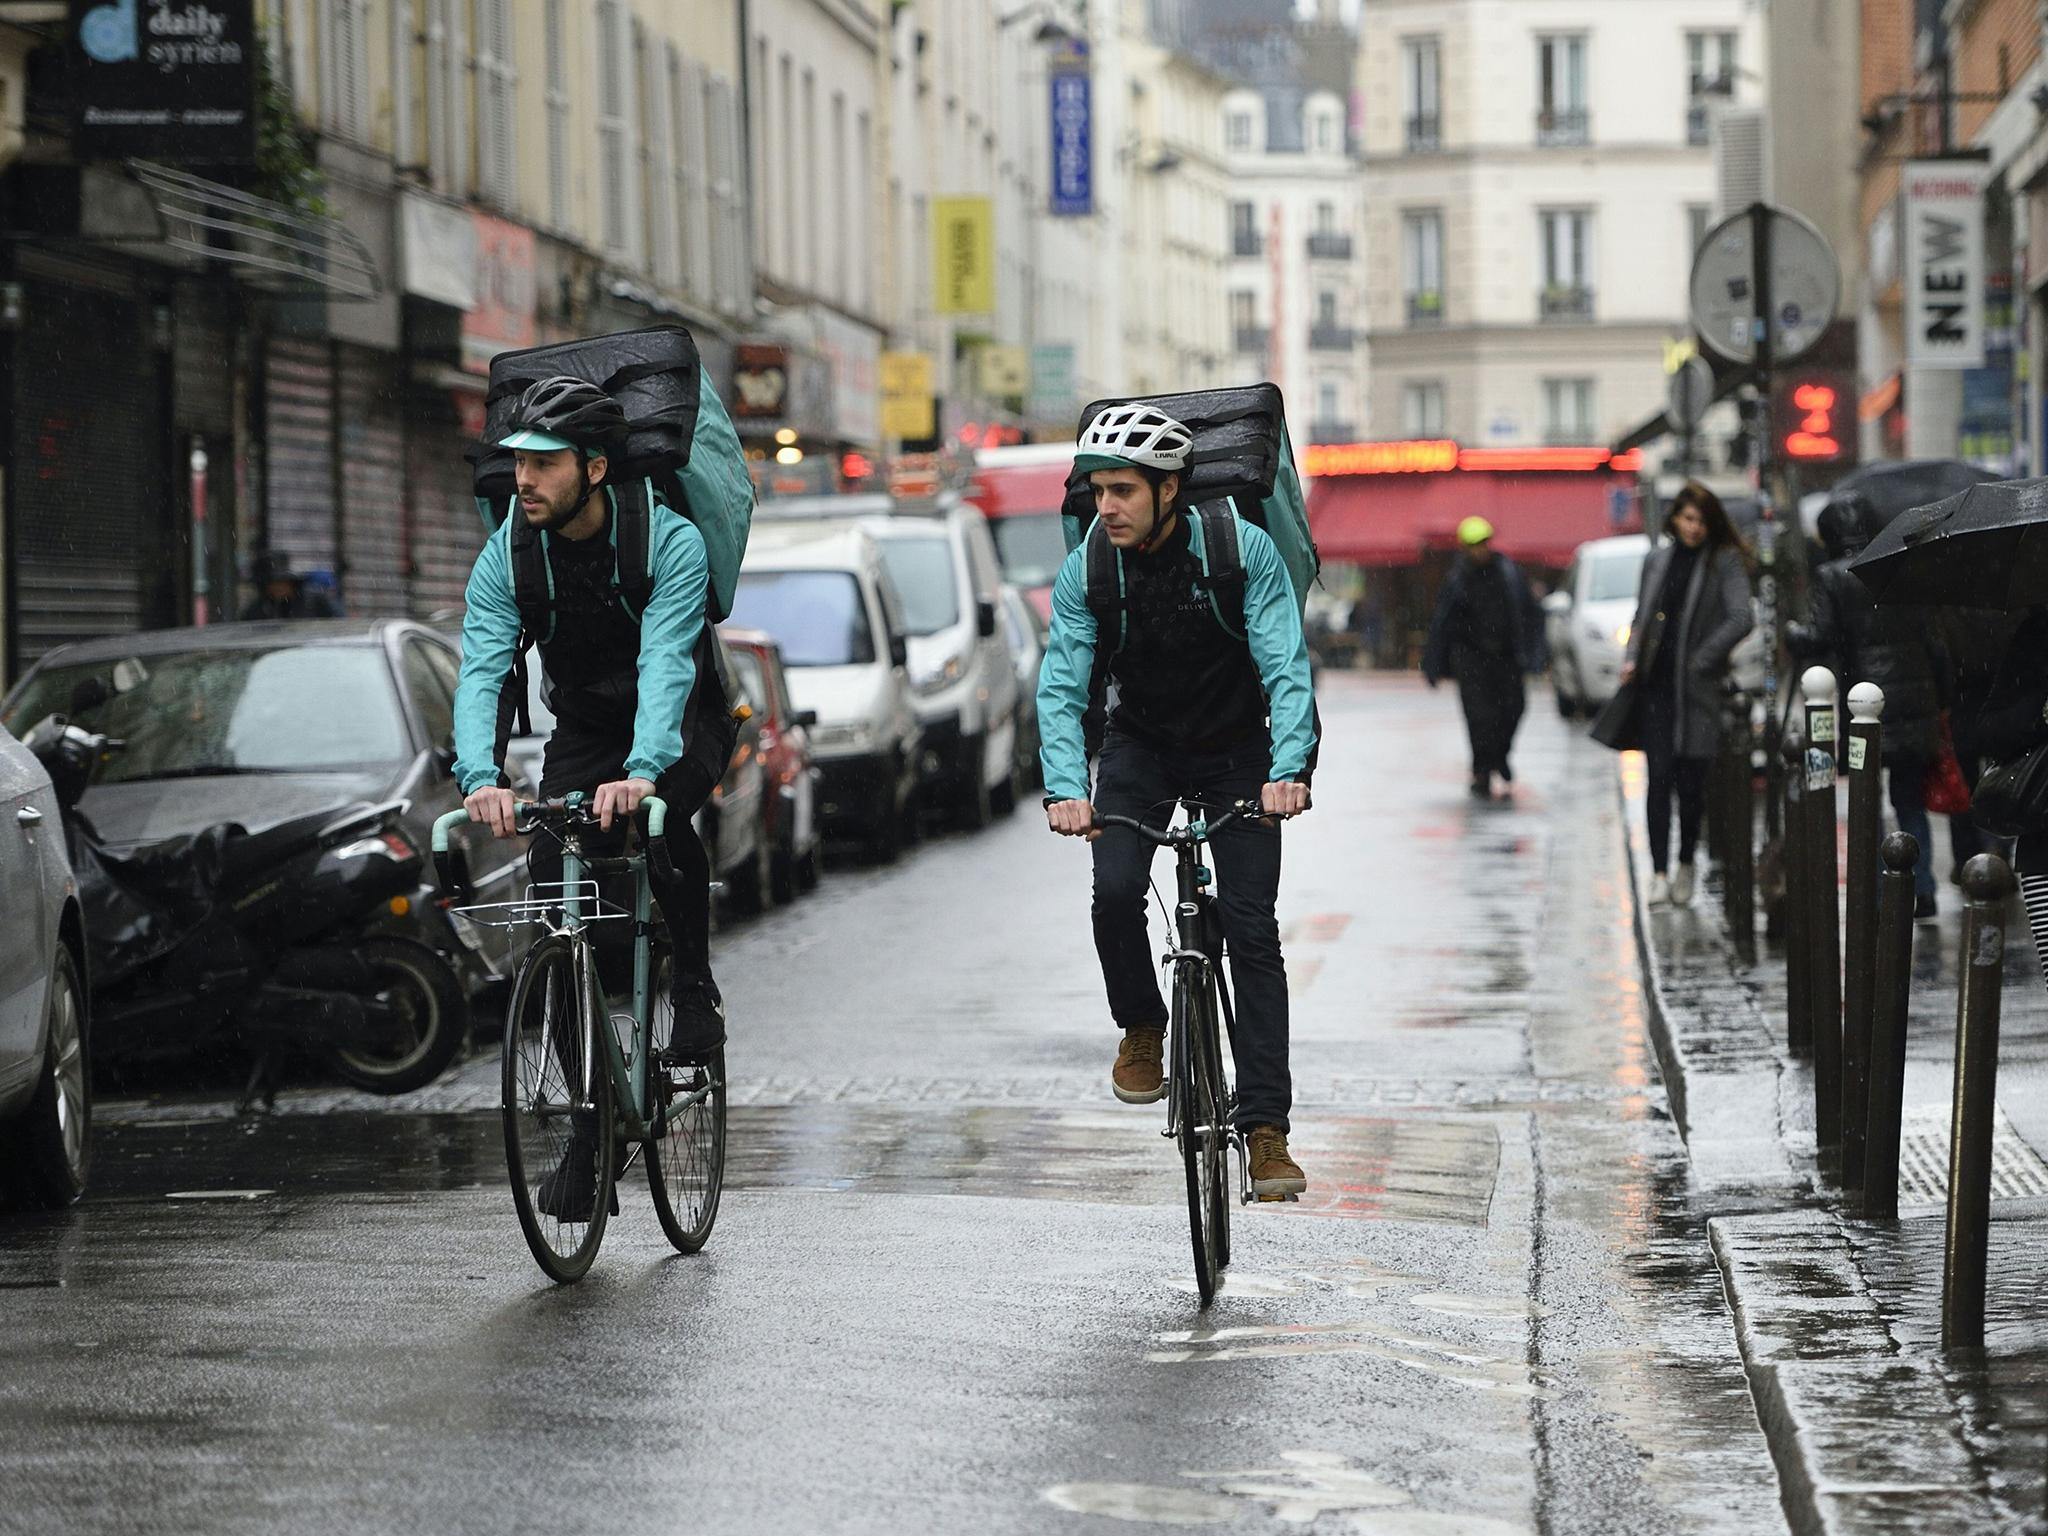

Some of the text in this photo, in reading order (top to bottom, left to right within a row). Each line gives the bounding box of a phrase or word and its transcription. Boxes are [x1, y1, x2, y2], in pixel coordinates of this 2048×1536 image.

[148, 4, 227, 45] daily
[1923, 211, 1967, 343] NEW
[1178, 603, 1210, 611] DELIVE
